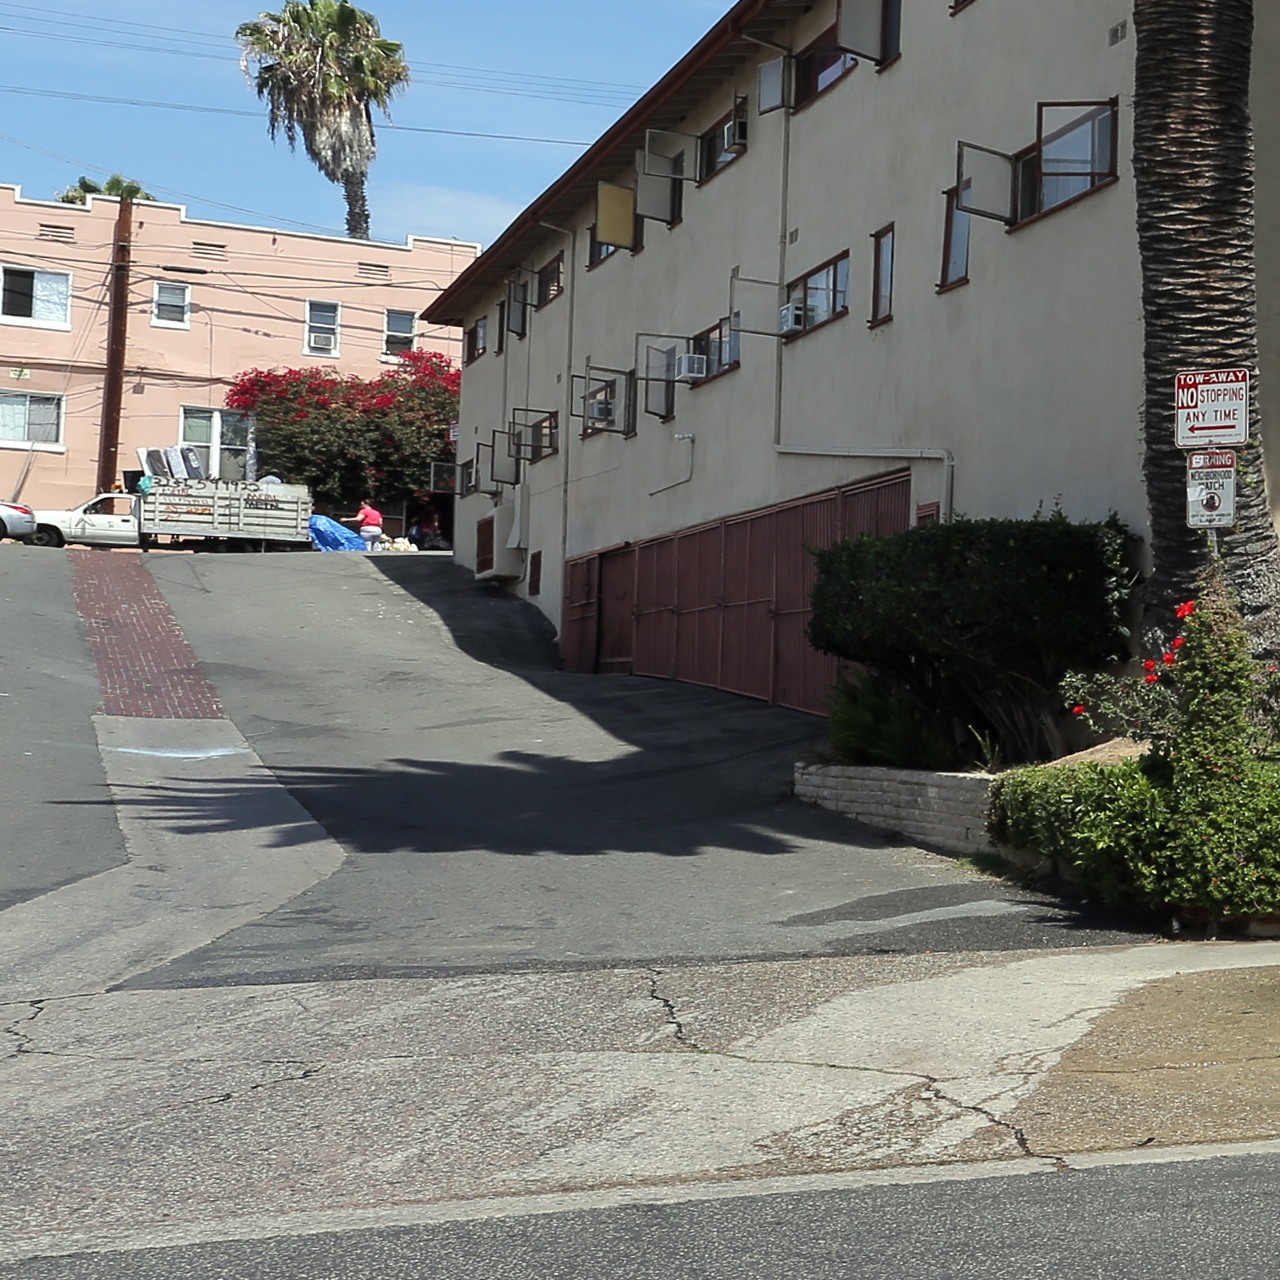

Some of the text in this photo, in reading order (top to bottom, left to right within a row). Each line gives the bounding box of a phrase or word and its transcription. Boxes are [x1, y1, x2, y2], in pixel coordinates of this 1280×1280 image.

[1179, 371, 1244, 385] TOW-AWAY
[1178, 387, 1244, 407] NO STOPPING
[1185, 409, 1238, 423] ANY TIME
[1192, 454, 1232, 467] RNING
